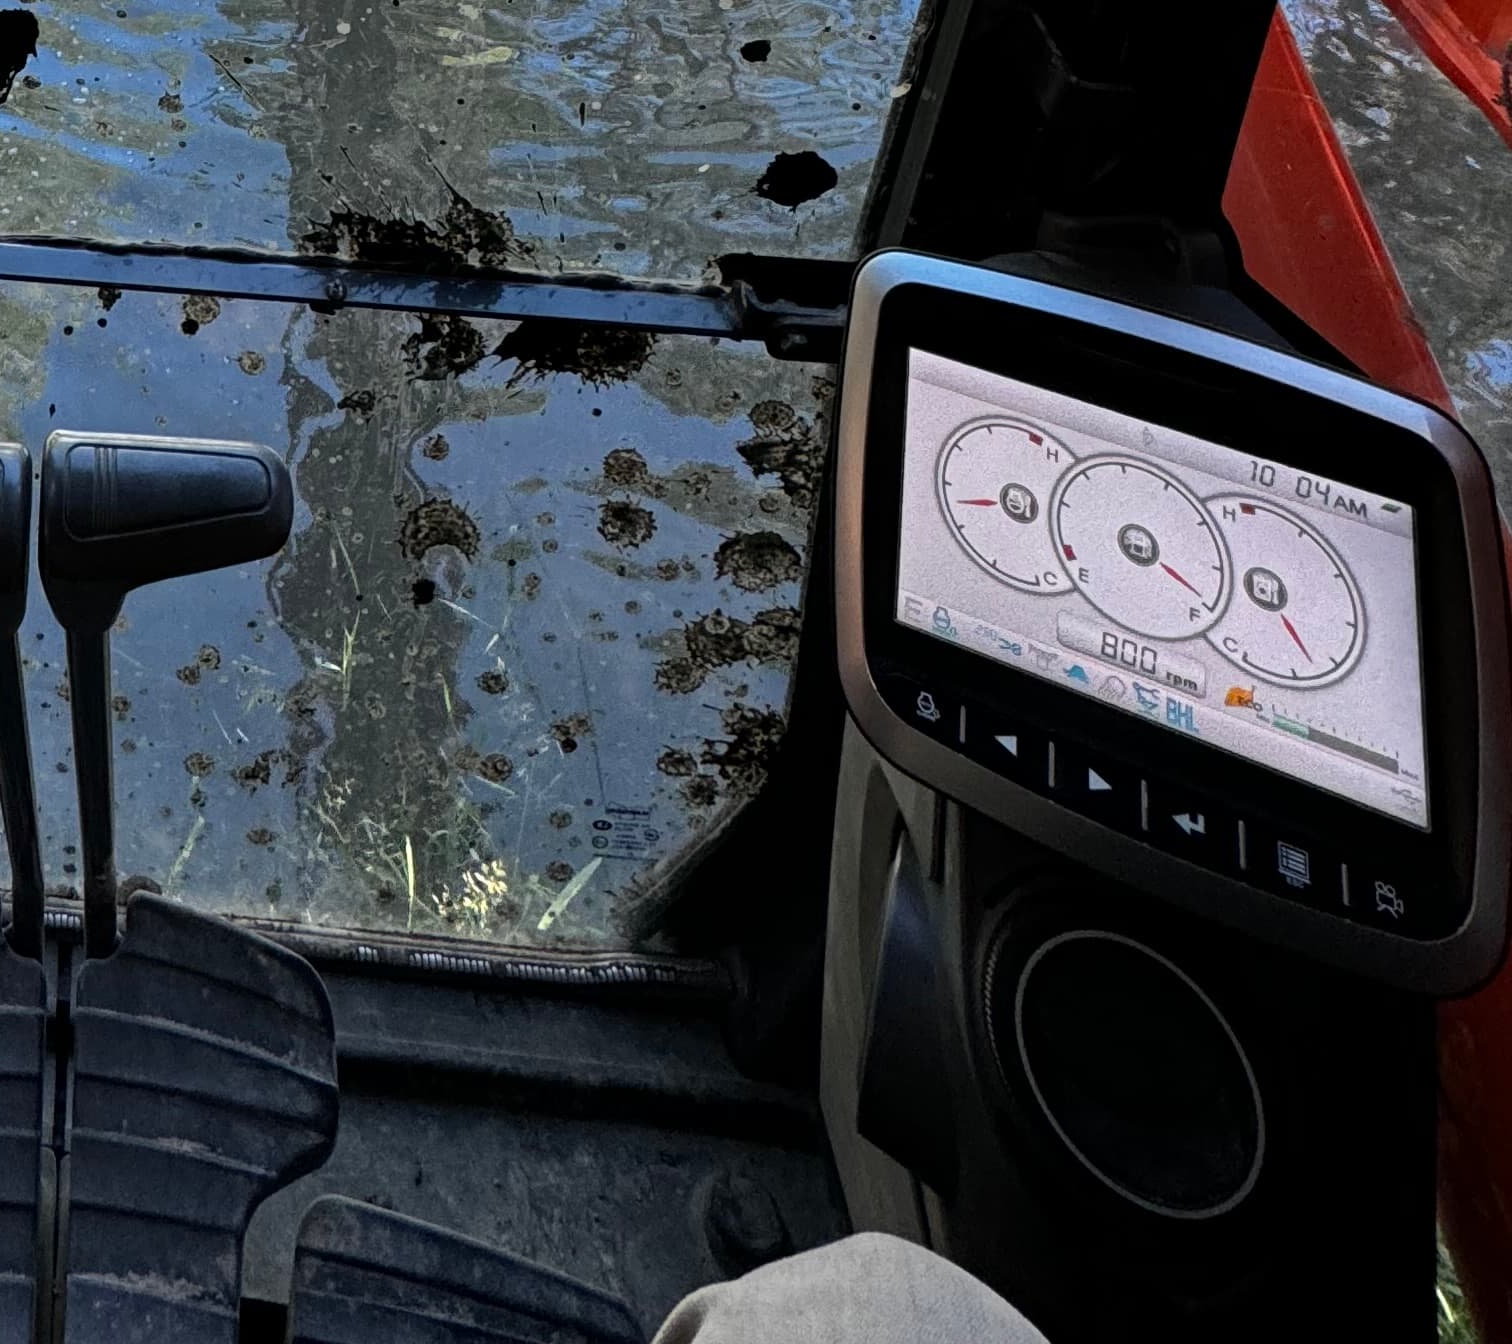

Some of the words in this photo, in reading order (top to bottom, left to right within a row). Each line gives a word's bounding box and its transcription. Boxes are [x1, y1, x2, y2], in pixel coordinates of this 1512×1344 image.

[1046, 447, 1059, 462] H
[1250, 460, 1276, 488] 10
[1223, 505, 1236, 522] H
[1043, 571, 1058, 586] C
[1078, 567, 1090, 583] E
[1189, 606, 1201, 621] F
[1223, 636, 1238, 653] C
[1101, 631, 1157, 675] 800
[1166, 671, 1199, 691] rpm
